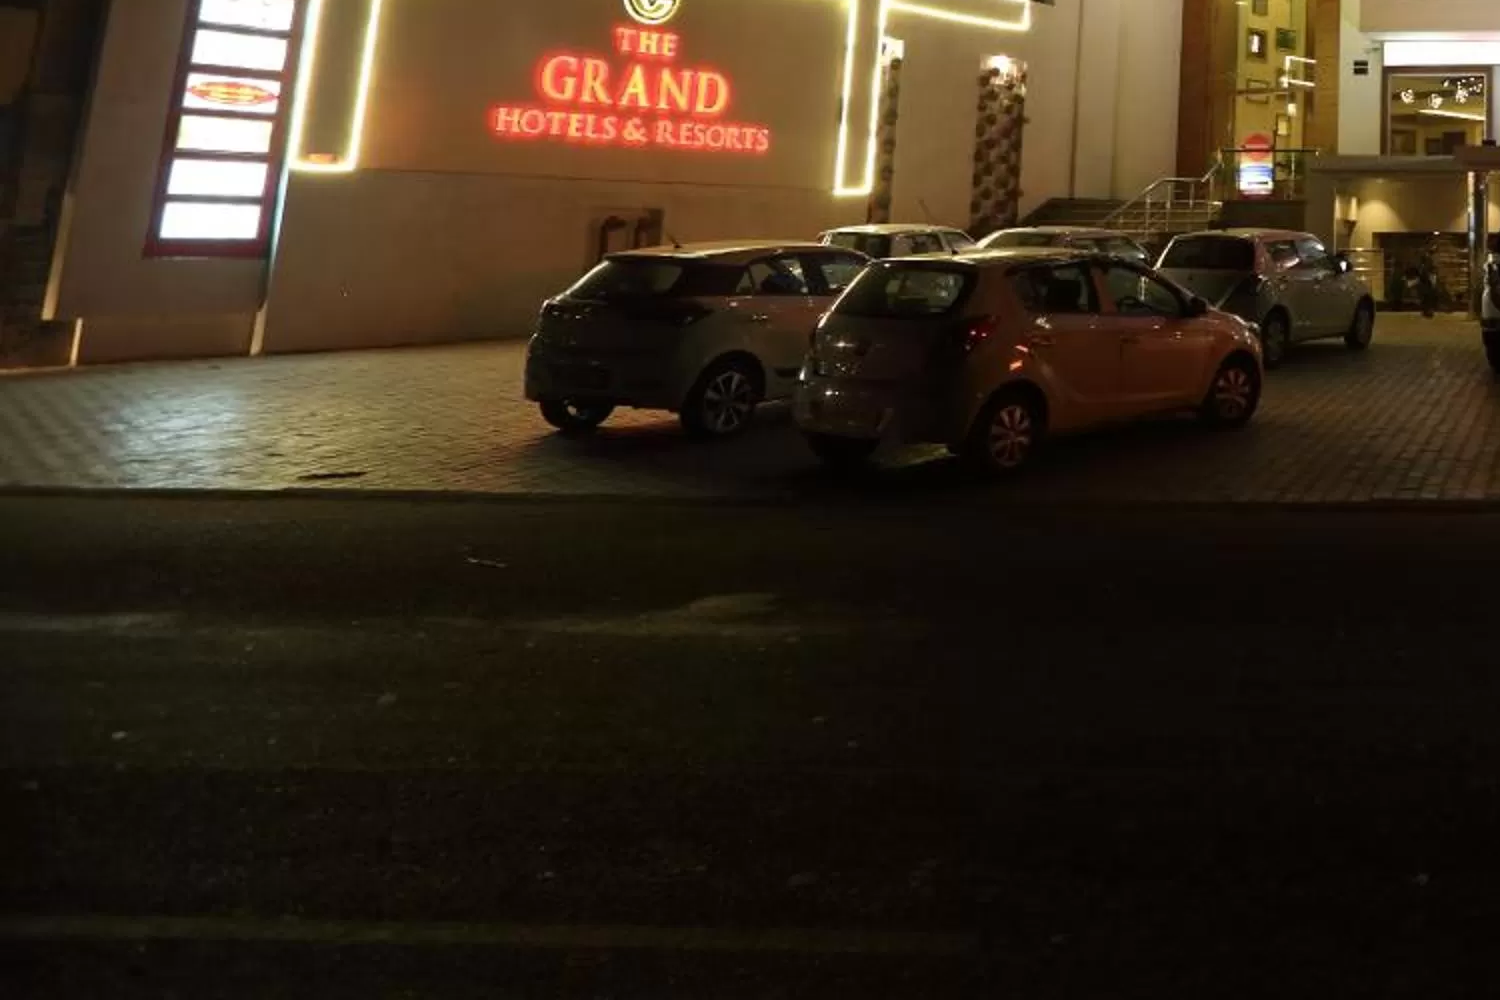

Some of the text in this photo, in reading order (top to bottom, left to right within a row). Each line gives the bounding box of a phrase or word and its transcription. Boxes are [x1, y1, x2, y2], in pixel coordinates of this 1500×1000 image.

[616, 27, 679, 57] THE
[541, 56, 729, 113] GRAND
[495, 107, 770, 151] HOTELS & RESORTS
